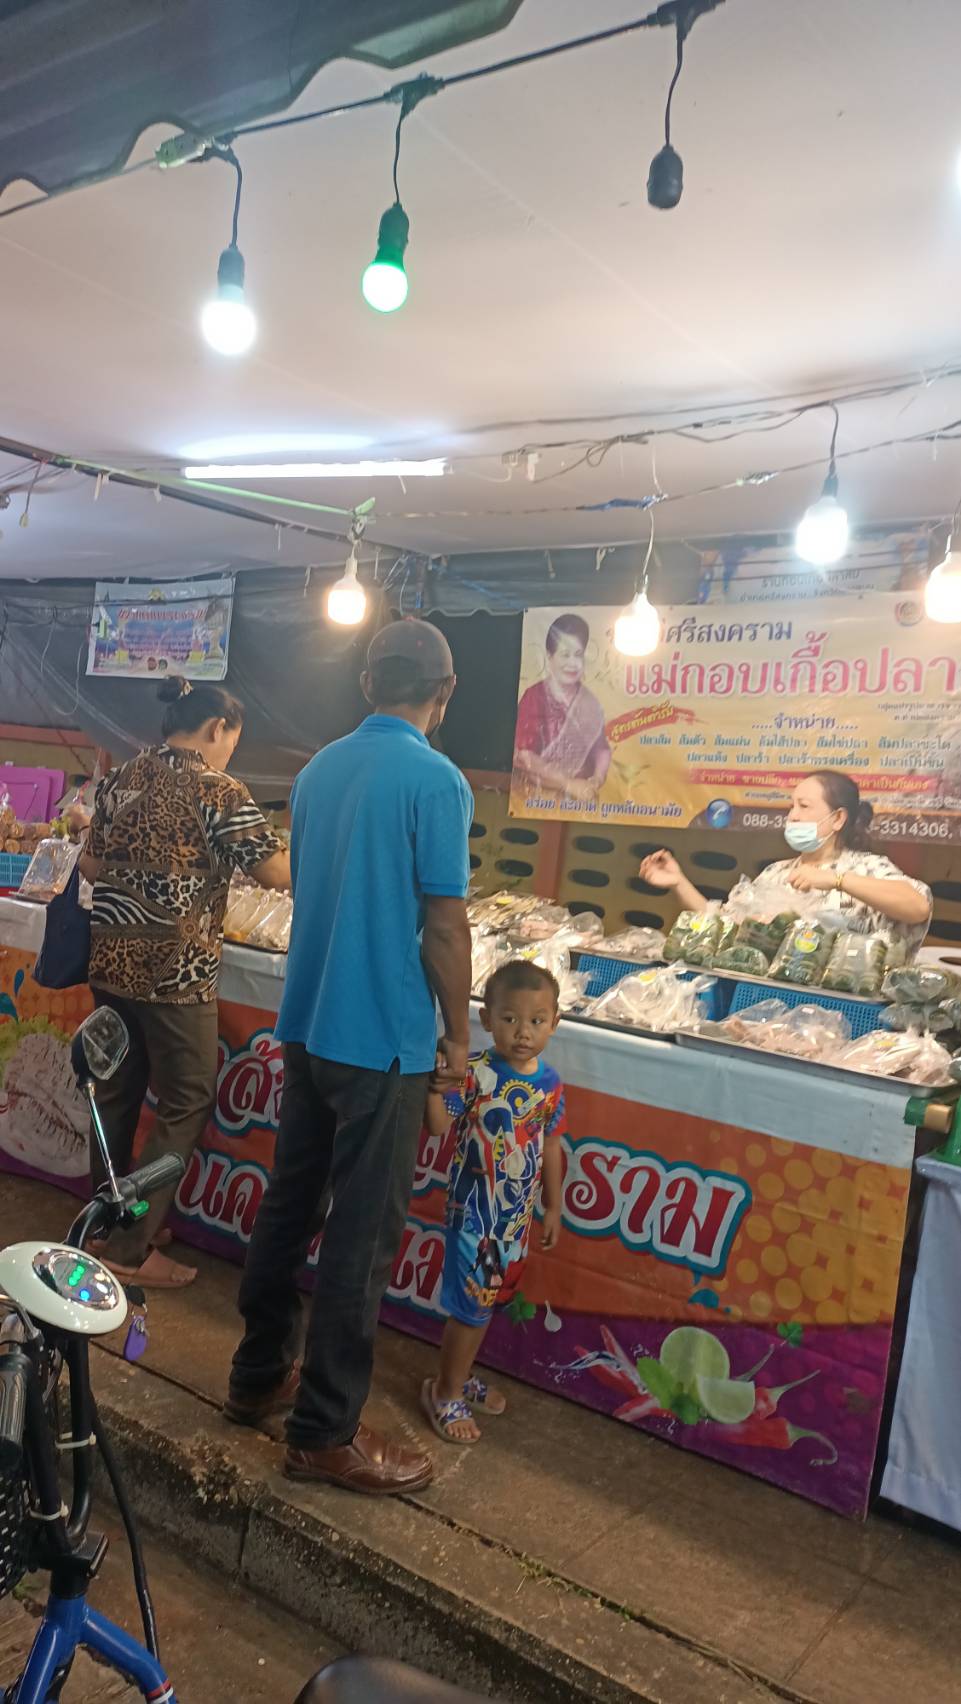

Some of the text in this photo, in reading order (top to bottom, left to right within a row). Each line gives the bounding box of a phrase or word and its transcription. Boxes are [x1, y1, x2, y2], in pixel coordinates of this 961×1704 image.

[625, 630, 961, 695] แม่กอบเกื้อปลา
